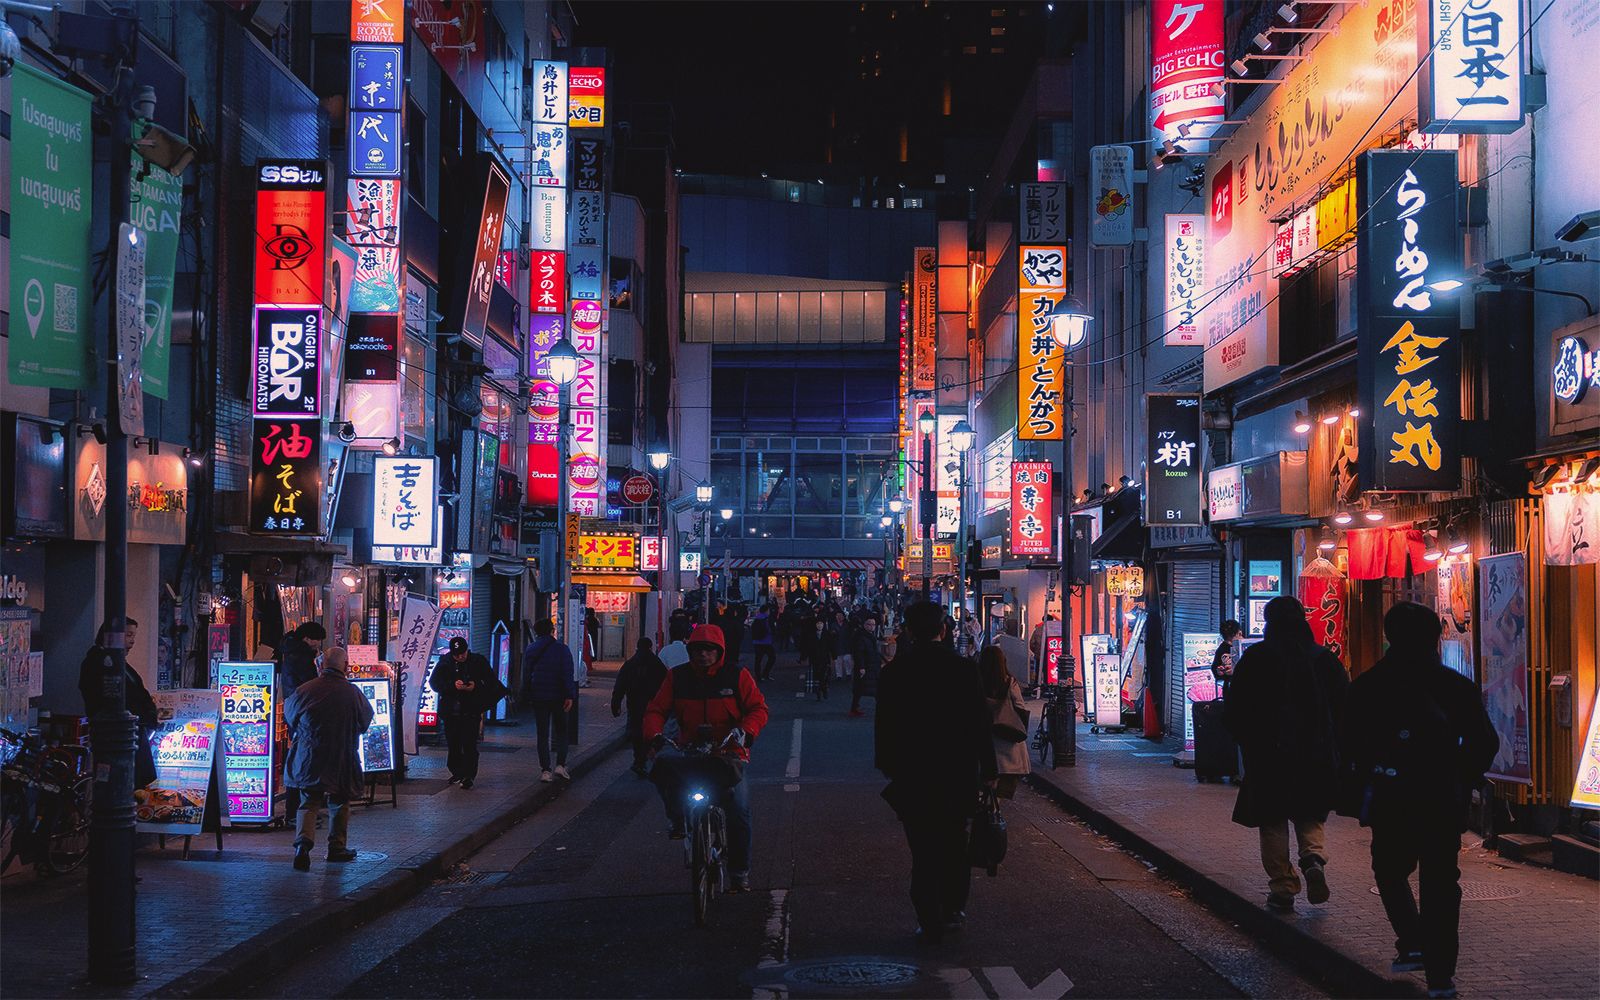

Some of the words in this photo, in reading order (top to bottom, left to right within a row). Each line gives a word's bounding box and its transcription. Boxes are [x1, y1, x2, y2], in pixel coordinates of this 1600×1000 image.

[357, 27, 394, 36] ROYAL
[1440, 30, 1451, 51] BAR
[1152, 60, 1175, 84] BIG
[1177, 50, 1224, 68] ECHO
[573, 78, 602, 87] ECHO
[1186, 84, 1209, 98] 受付
[260, 165, 323, 183] SSビル
[541, 193, 556, 201] Bar
[1214, 183, 1230, 223] 2F
[1396, 169, 1431, 311] らーめん
[573, 260, 600, 277] 梅
[1024, 251, 1062, 284] かつや
[538, 253, 557, 305] バラの木
[304, 315, 316, 359] ONIGIRI
[304, 361, 314, 370] &
[1031, 296, 1056, 435] カツ丼・とんかつ
[256, 346, 268, 410] HIROMATSU
[574, 335, 594, 442] RAKUEN
[1381, 320, 1449, 471] 金伝丸
[304, 396, 314, 411] 2F
[1157, 431, 1176, 439] パブ
[261, 423, 312, 466] 油
[1154, 440, 1196, 467] 梢
[1015, 471, 1047, 483] 焼肉
[273, 464, 302, 514] そば
[391, 463, 421, 531] 吉そば
[263, 516, 304, 530] 春日亭
[1166, 510, 1182, 519] B1
[578, 539, 633, 558] メン王
[594, 597, 628, 606] ラーメン
[230, 670, 245, 683] 2F
[221, 686, 237, 698] 2F
[242, 801, 264, 809] BAR
